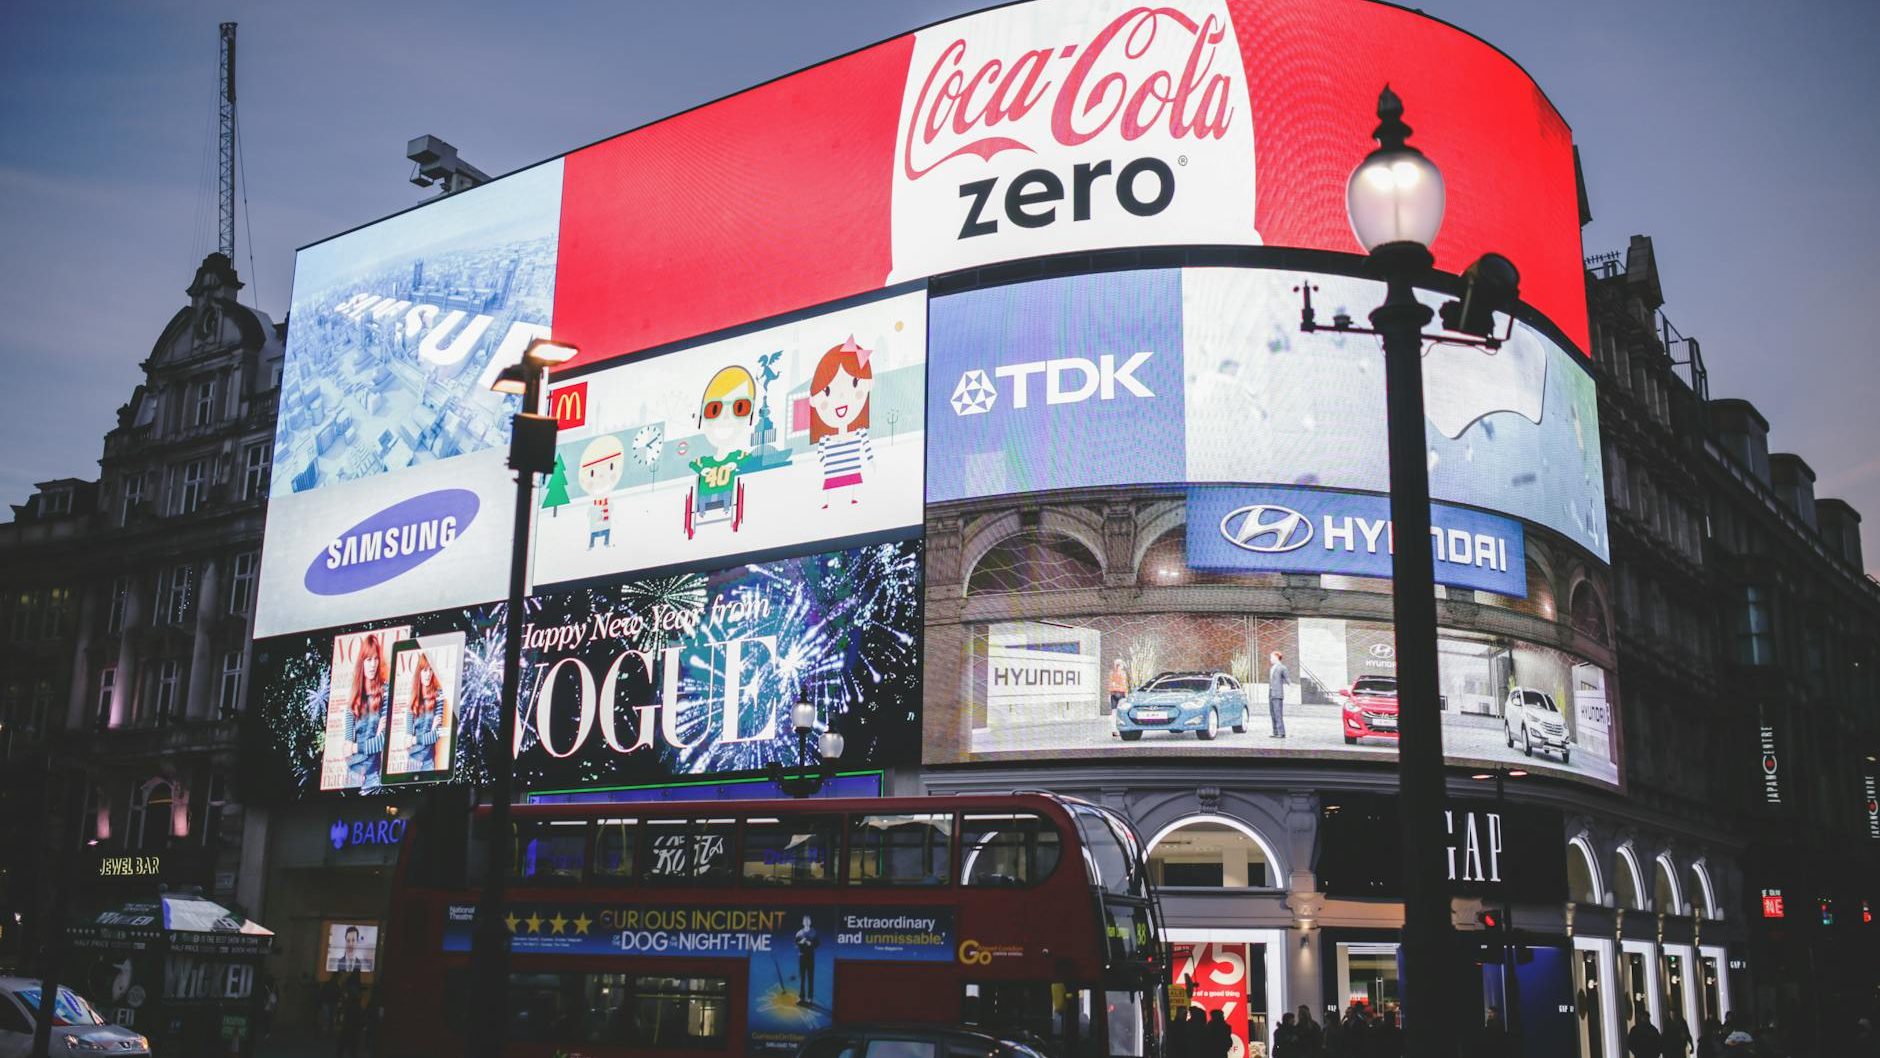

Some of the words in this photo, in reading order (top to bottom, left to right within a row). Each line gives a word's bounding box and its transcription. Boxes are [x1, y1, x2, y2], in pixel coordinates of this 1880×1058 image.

[904, 6, 1233, 178] Coca-Cola
[957, 156, 1175, 238] zero
[995, 352, 1155, 409] TDK
[705, 465, 732, 488] 40
[326, 516, 456, 569] SAMSUNG
[1323, 515, 1507, 571] HYNDAI
[589, 611, 644, 641] New
[649, 603, 706, 643] Year
[705, 594, 771, 631] from
[994, 667, 1081, 686] HYUNDAI
[100, 857, 133, 876] JEWEL
[136, 856, 160, 875] BAR
[448, 905, 476, 914] National
[600, 910, 687, 930] CURIOUS
[691, 909, 786, 931] INCIDENT
[621, 931, 669, 951] DOG
[679, 932, 772, 952] NIGHT-TIME
[837, 932, 862, 944] and
[958, 939, 992, 965] Go
[1176, 942, 1245, 985] 75
[1209, 990, 1224, 998] good
[1225, 990, 1241, 998] thing
